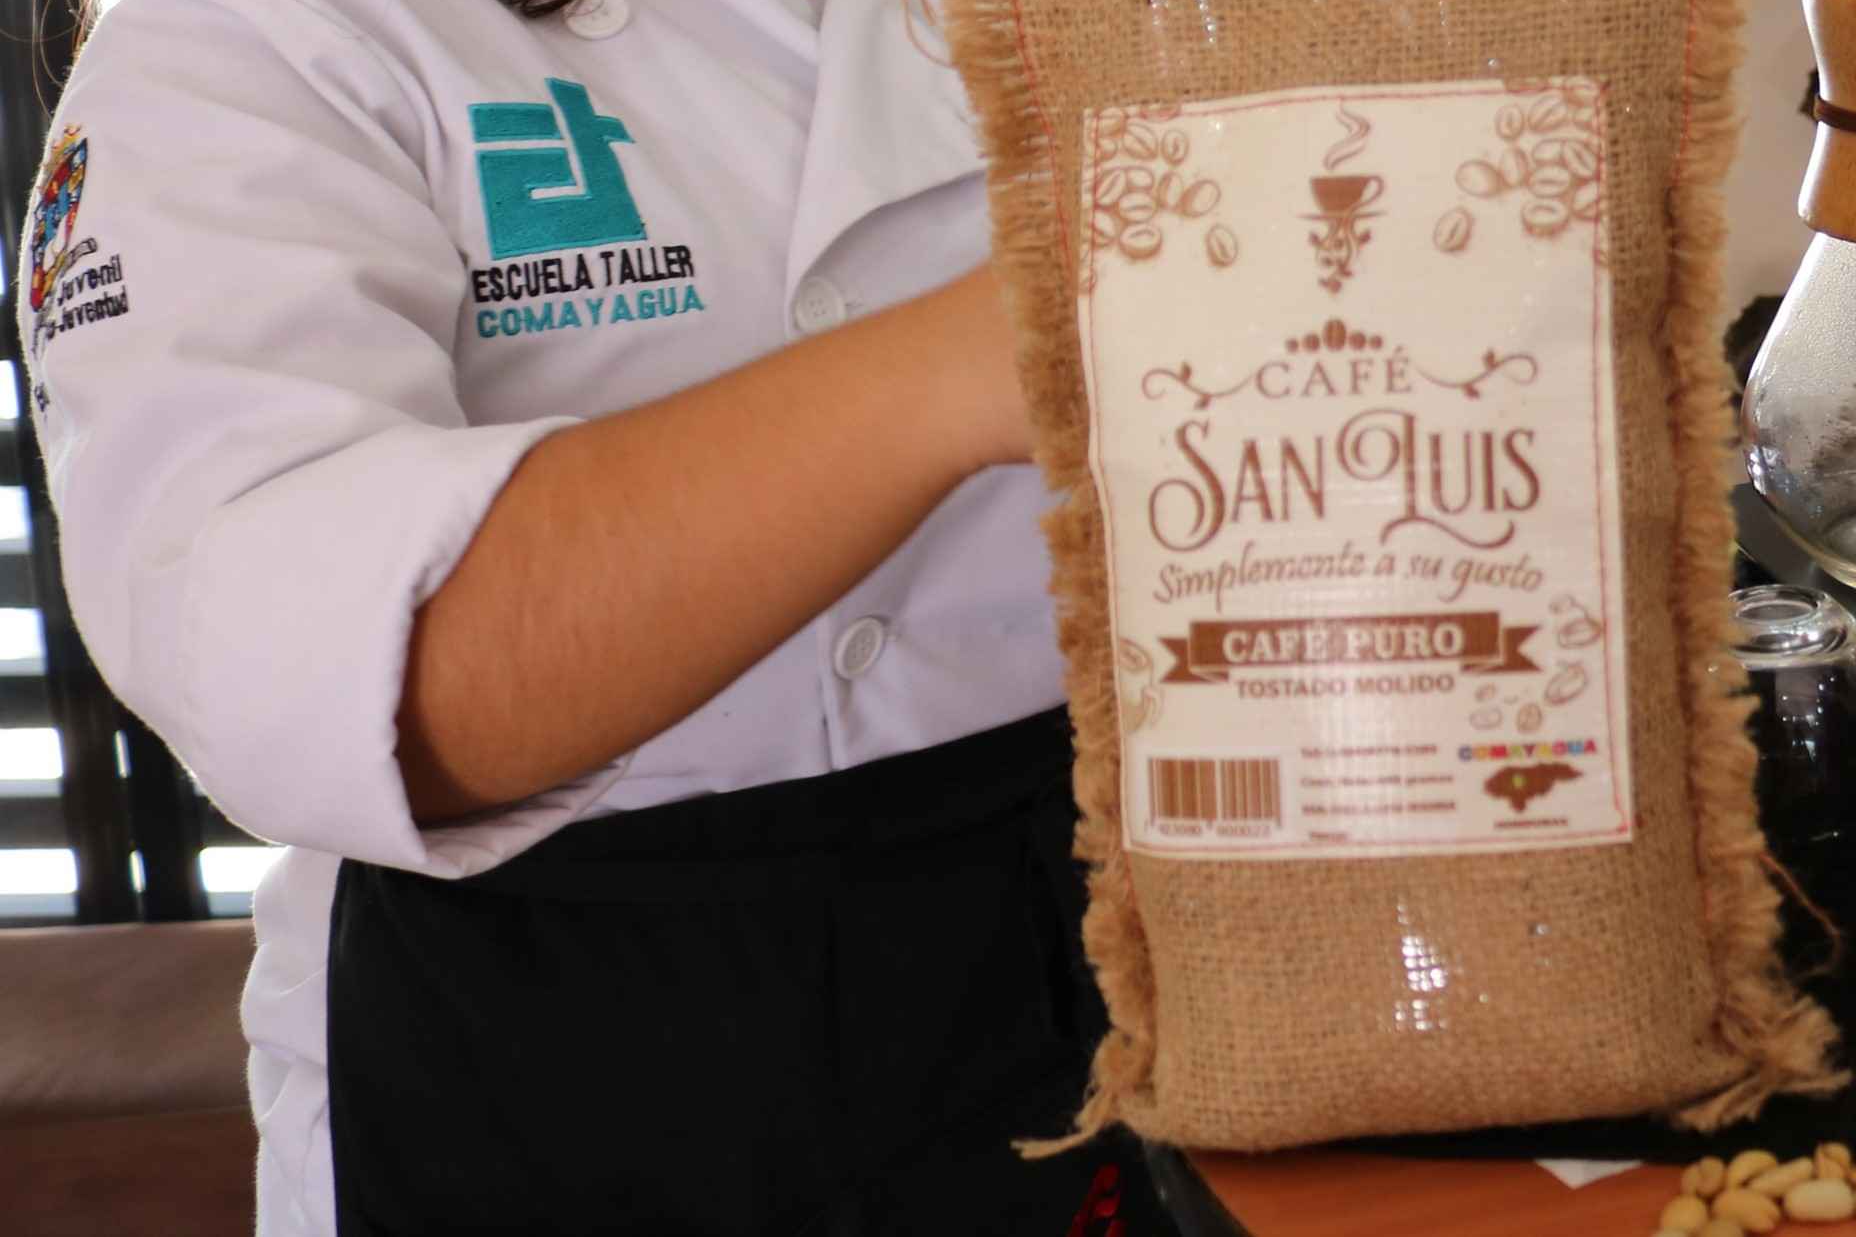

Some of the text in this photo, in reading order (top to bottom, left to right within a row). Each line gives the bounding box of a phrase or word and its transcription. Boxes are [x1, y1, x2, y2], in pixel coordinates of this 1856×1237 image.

[472, 245, 695, 303] ESCUELA TALLER
[477, 284, 705, 339] COMAYAGUA
[1255, 345, 1413, 400] CAFÉ
[1152, 539, 1544, 613] Simplemente a su gusto
[1344, 621, 1466, 662] PURO
[1236, 673, 1456, 700] TOSTADO MOLIDO
[1458, 738, 1598, 762] COMAYAGUA
